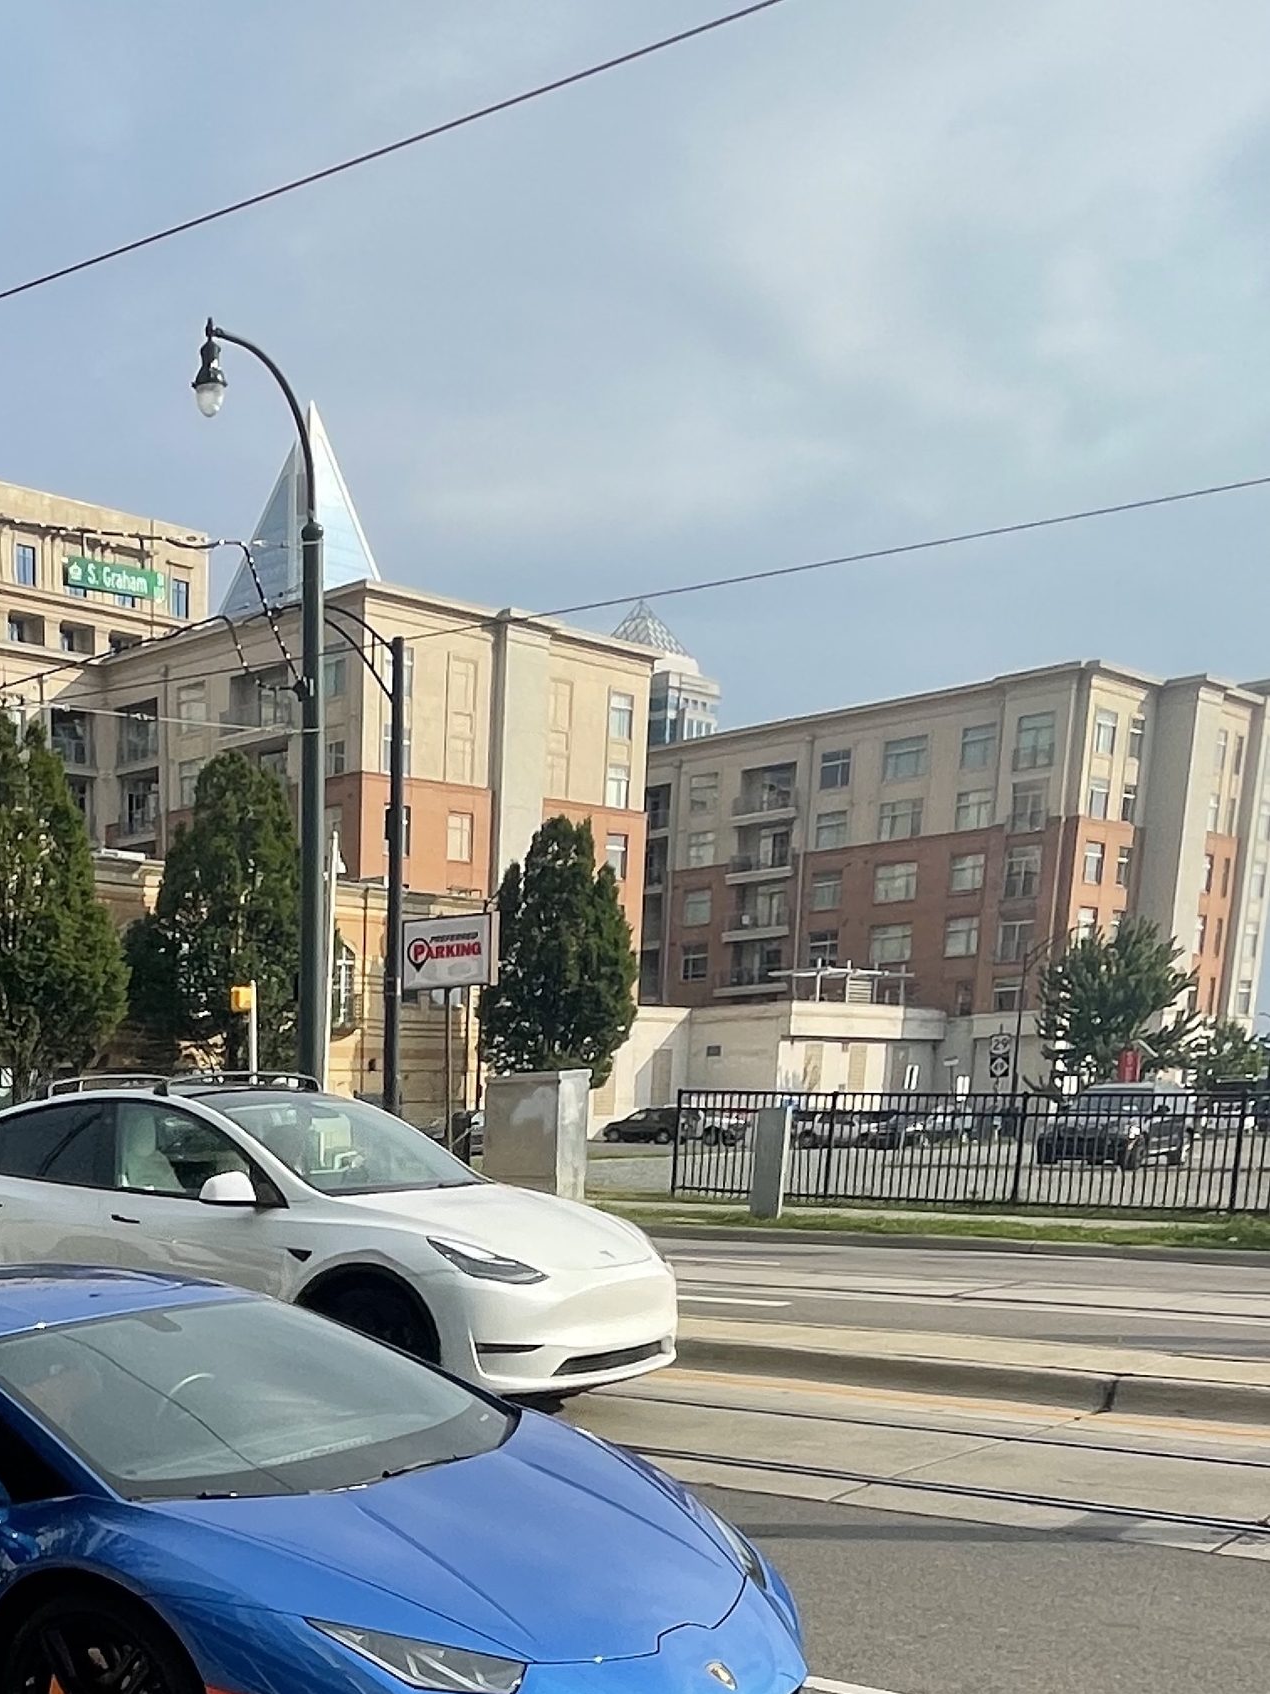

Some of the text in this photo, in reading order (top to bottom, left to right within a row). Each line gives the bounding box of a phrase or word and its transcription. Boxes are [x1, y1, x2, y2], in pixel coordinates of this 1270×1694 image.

[87, 562, 99, 585] S.
[102, 566, 148, 594] Graham
[413, 941, 482, 961] PARKING
[992, 1037, 1009, 1050] 29
